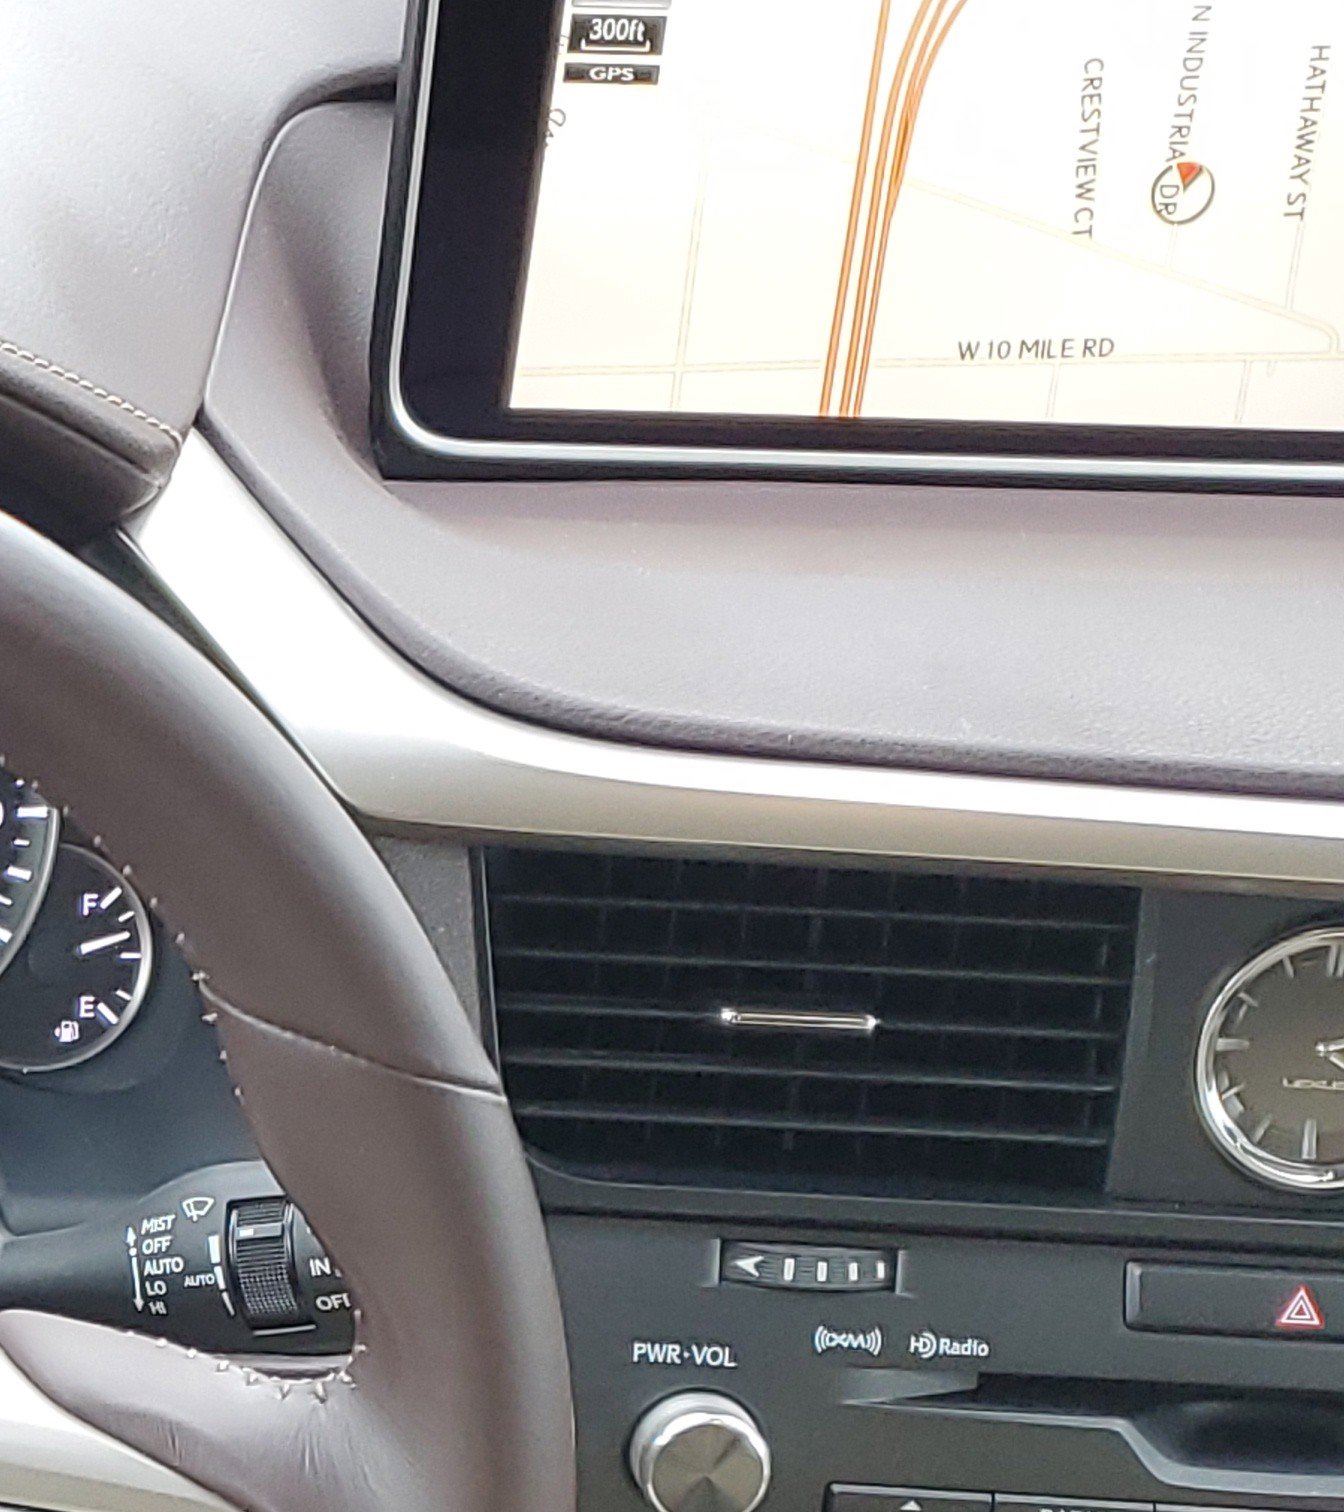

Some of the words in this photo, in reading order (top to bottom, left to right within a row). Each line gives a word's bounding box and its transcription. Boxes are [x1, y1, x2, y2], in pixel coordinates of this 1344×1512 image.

[588, 17, 646, 42] 300ft
[588, 66, 635, 81] GPS
[1165, 31, 1208, 163] INDUSTRIA
[1289, 45, 1331, 185] HATHAWAY
[1075, 58, 1104, 201] CRESTVIEW
[1158, 184, 1180, 216] DR
[1283, 192, 1307, 221] ST
[1071, 207, 1094, 239] CT
[958, 340, 980, 361] W
[988, 340, 1012, 360] 10
[1018, 338, 1075, 360] MILE
[1082, 337, 1115, 358] RD
[82, 894, 98, 916] F
[79, 998, 95, 1018] E
[141, 1214, 176, 1235] MIST
[141, 1236, 173, 1255] OFF
[144, 1257, 184, 1276] AUTO
[145, 1280, 167, 1296] LO
[184, 1272, 215, 1288] AUTO
[939, 1338, 989, 1356] Radio
